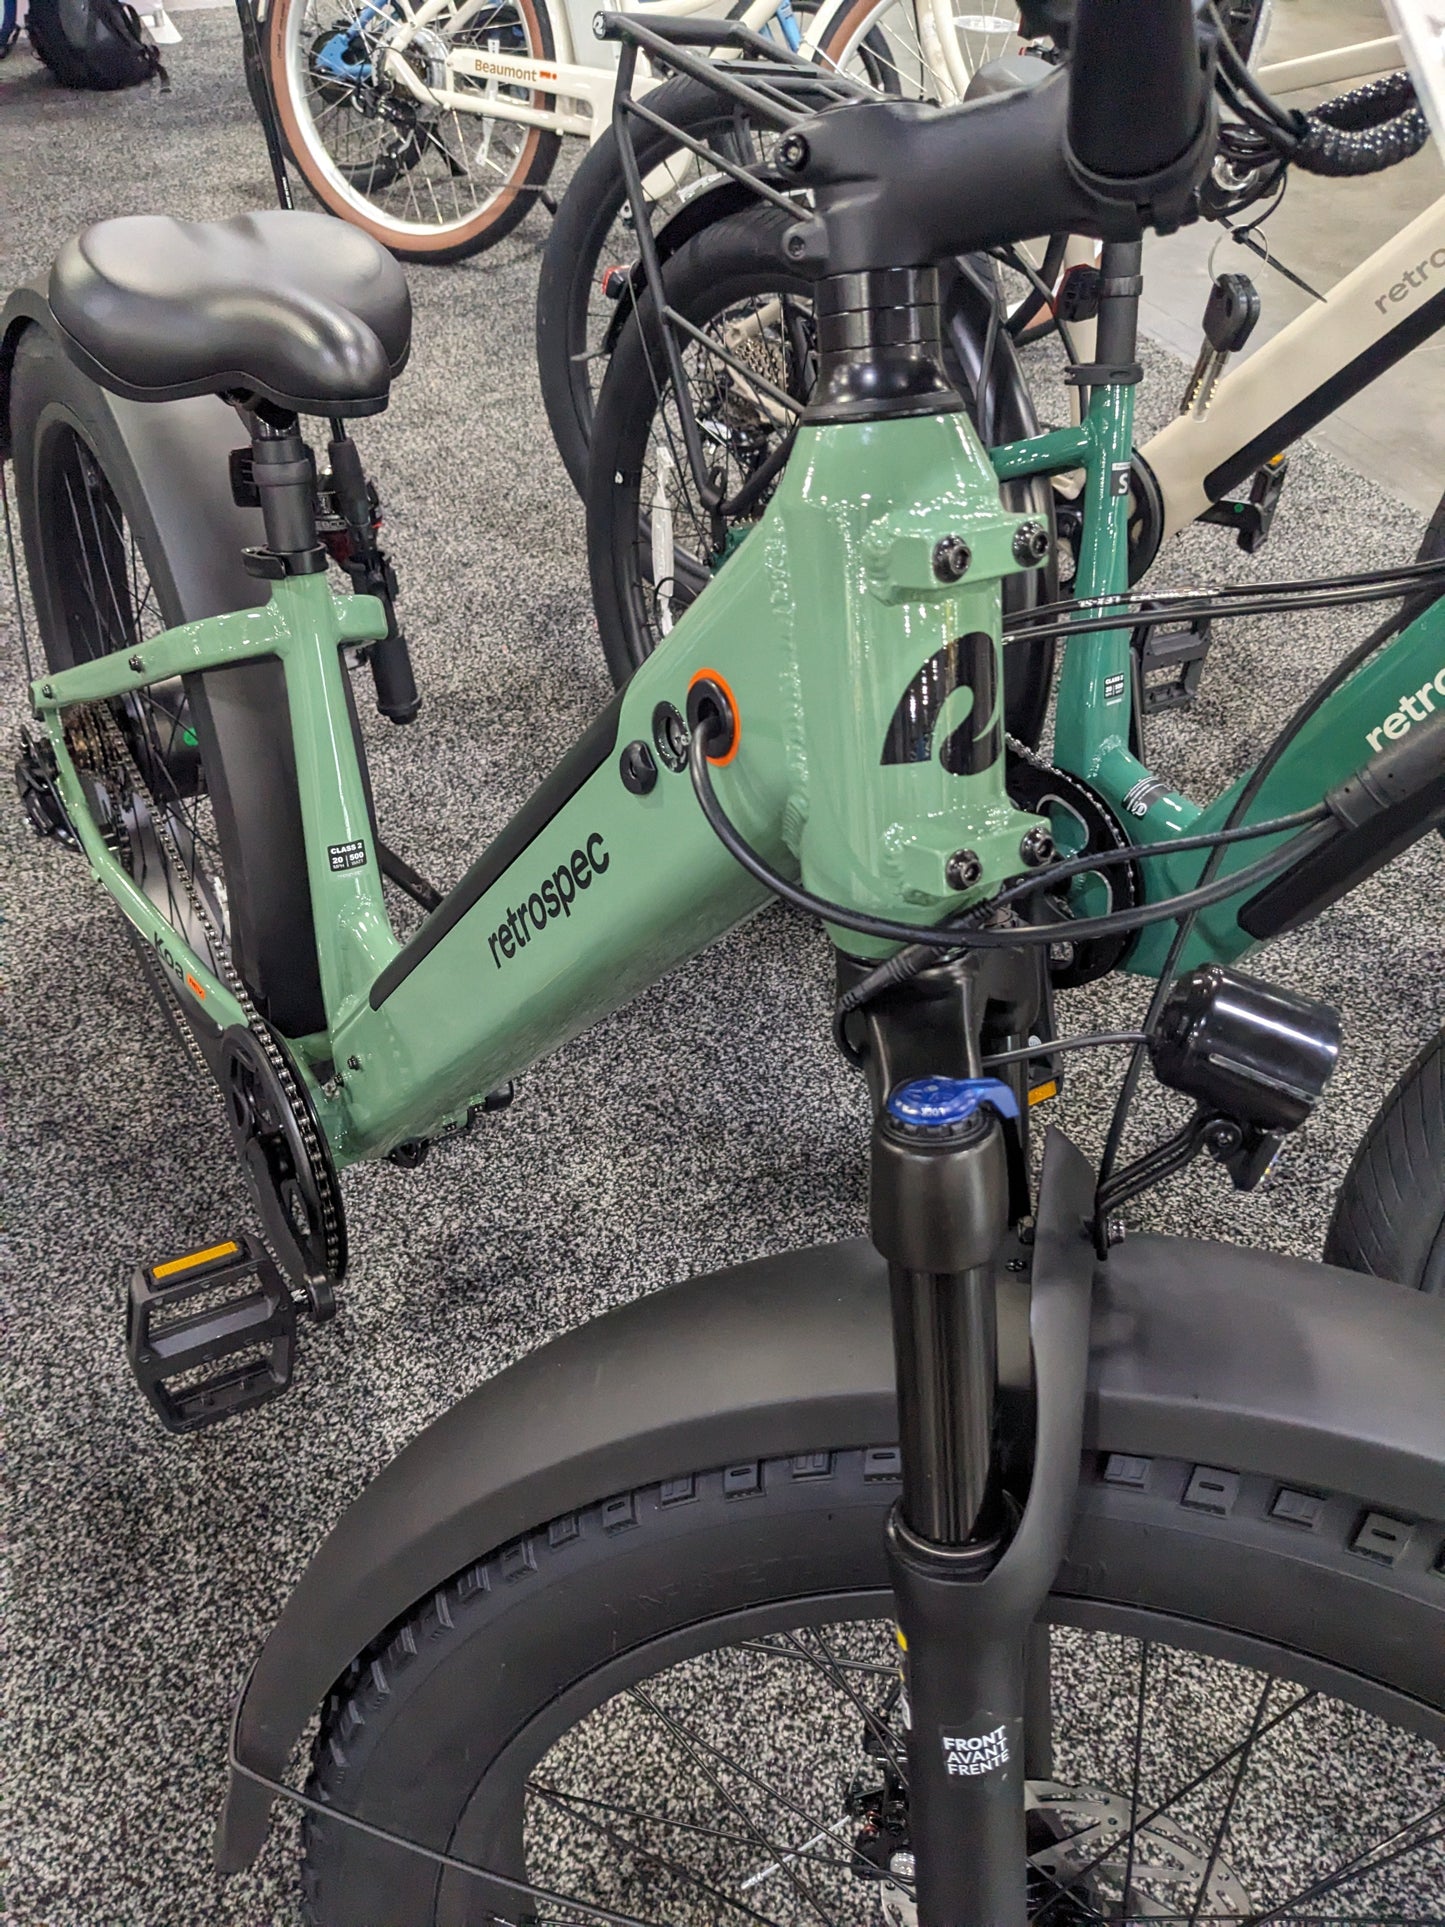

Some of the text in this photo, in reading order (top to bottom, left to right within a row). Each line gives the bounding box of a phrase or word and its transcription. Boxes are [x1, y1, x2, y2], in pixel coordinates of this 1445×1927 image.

[474, 59, 538, 82] Beaumont
[1118, 472, 1129, 494] S
[330, 844, 357, 855] CLASS
[332, 851, 364, 864] 20 500
[488, 832, 610, 970] retrospec
[942, 1725, 1006, 1751] FRONT
[946, 1737, 1008, 1764] AVANT
[947, 1749, 1010, 1776] FRENTE
